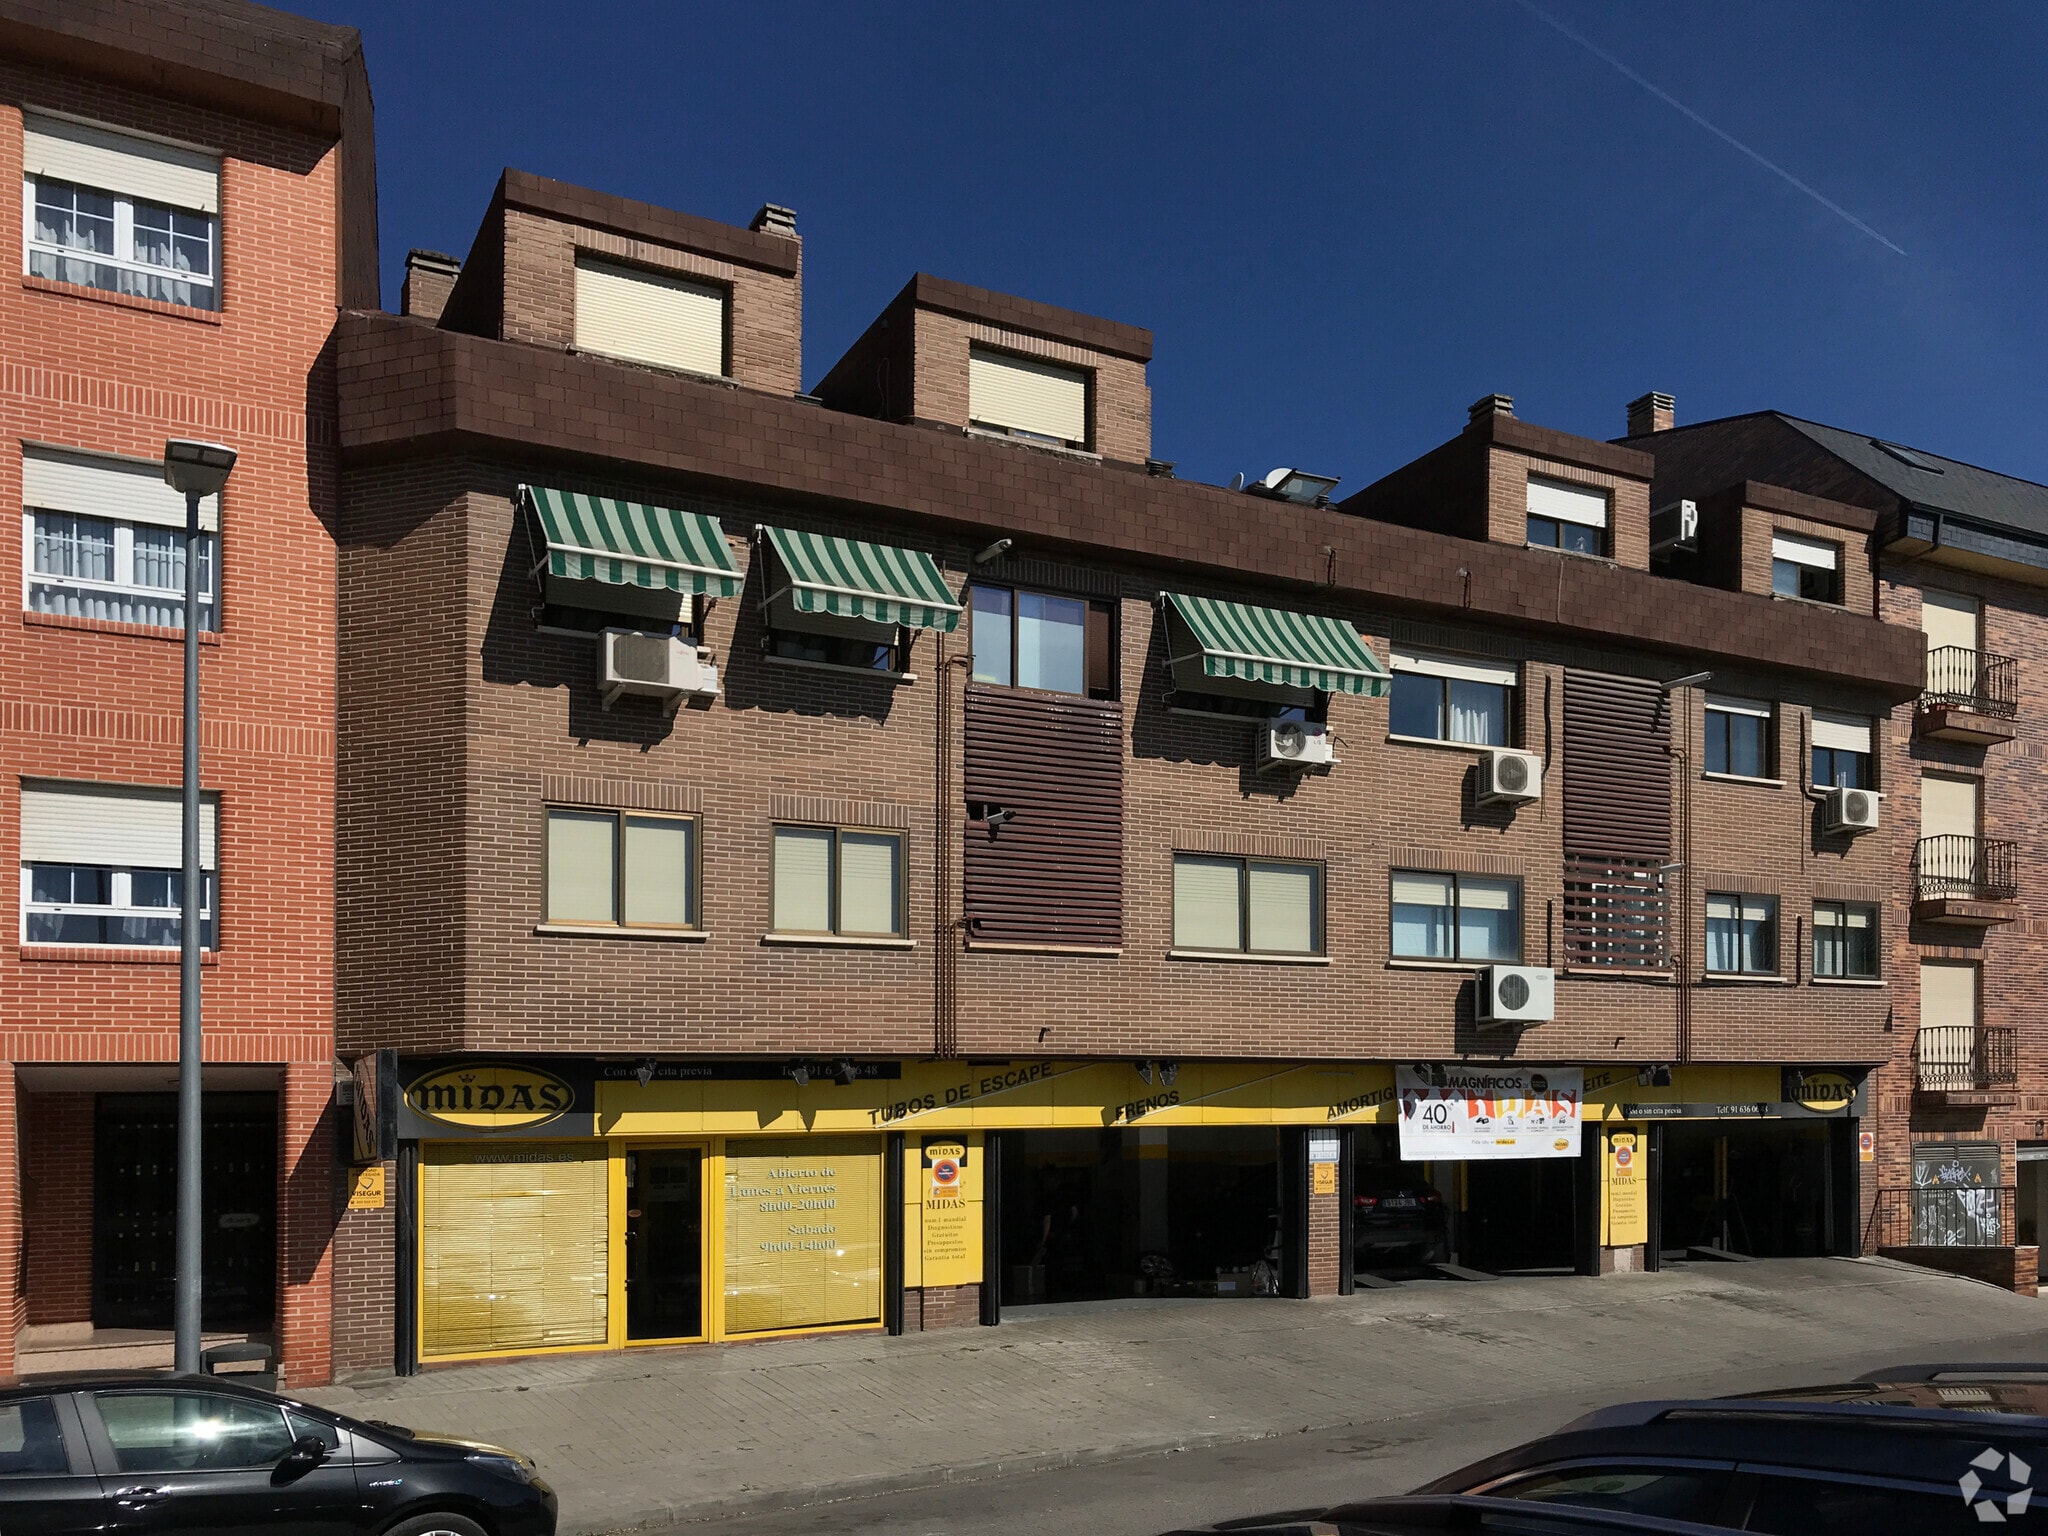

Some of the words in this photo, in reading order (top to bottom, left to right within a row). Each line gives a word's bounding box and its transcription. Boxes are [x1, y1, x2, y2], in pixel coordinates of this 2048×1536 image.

[604, 1067, 627, 1077] Con
[658, 1066, 677, 1076] cita
[680, 1067, 713, 1078] previa
[864, 1065, 878, 1075] 48
[1449, 1075, 1523, 1089] MAGNÍFICOS
[411, 1083, 562, 1111] MIDAS
[867, 1094, 936, 1125] TUBOS
[945, 1084, 972, 1105] DE
[980, 1062, 1052, 1095] ESCAPE
[1115, 1090, 1180, 1119] FRENOS
[1730, 1105, 1738, 1113] 91
[1739, 1105, 1751, 1113] 636
[1643, 1106, 1652, 1114] sin
[1653, 1106, 1664, 1115] cita
[1664, 1107, 1682, 1116] previa
[474, 1151, 574, 1163] www.midas.es
[929, 1147, 961, 1156] MIDAS
[768, 1168, 818, 1179] Abierto
[820, 1166, 836, 1177] de
[1611, 1177, 1637, 1186] MIDAS
[730, 1186, 772, 1198] Lunes
[775, 1187, 785, 1196] a
[787, 1183, 837, 1195] Viernes
[926, 1199, 966, 1210] MIDAS
